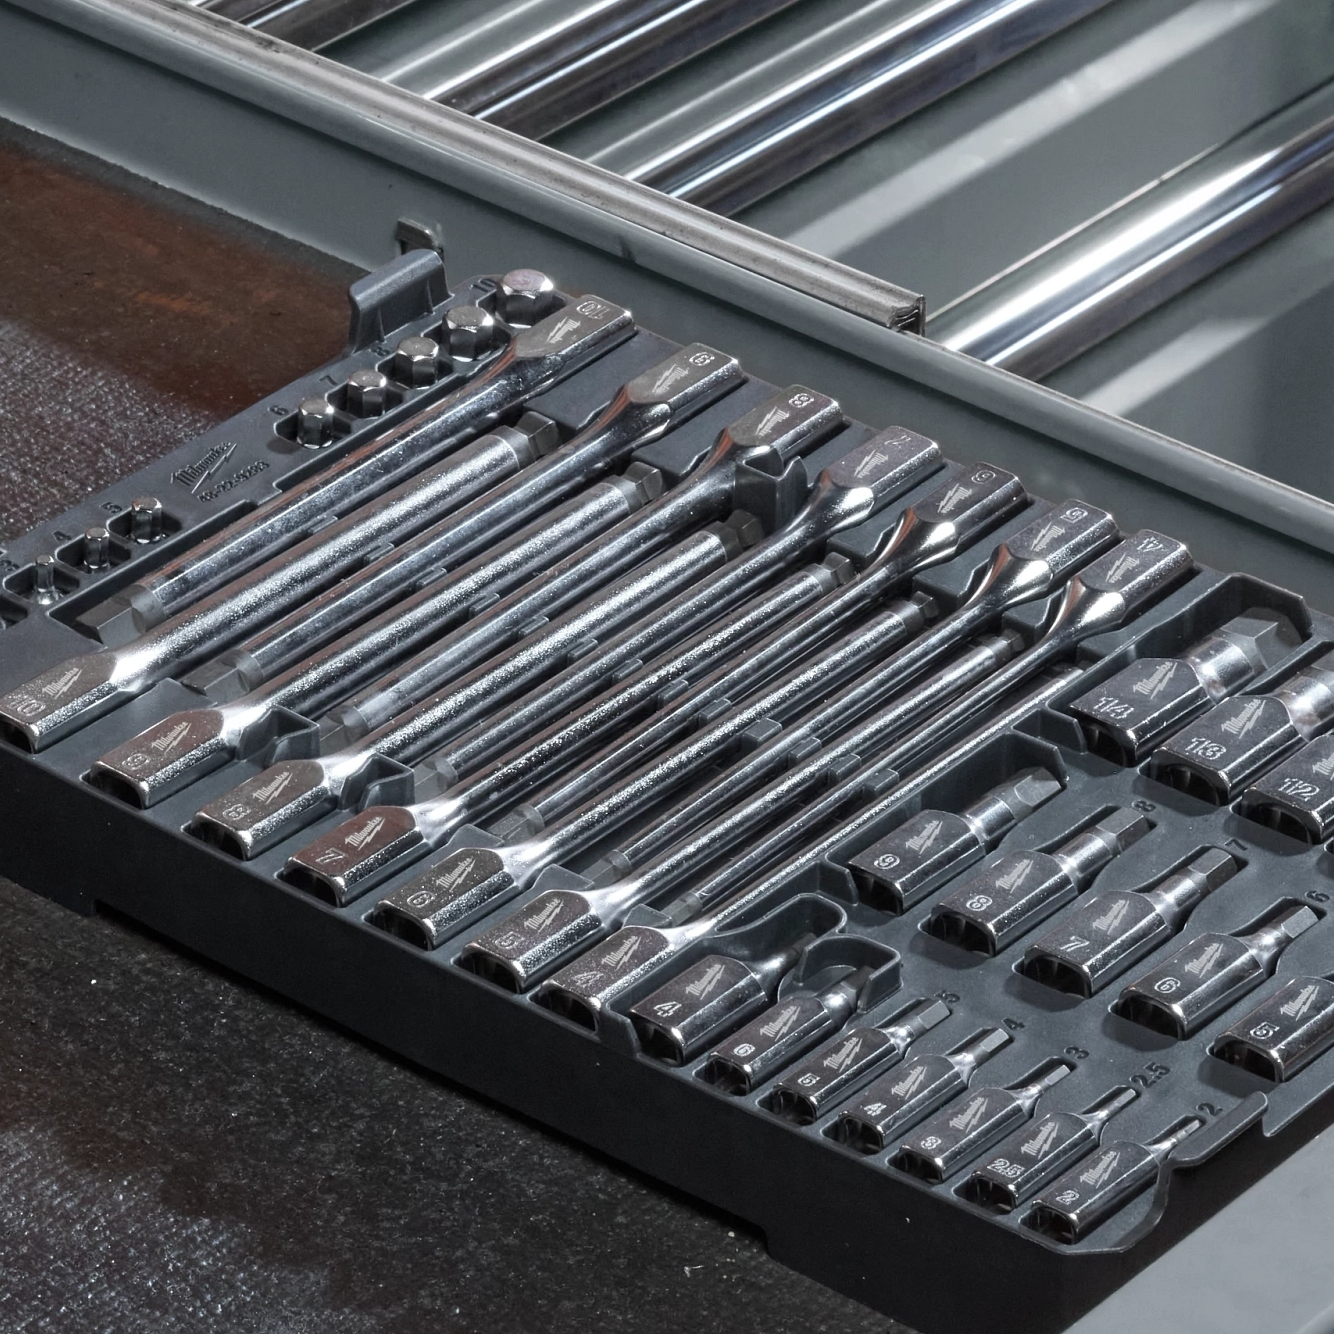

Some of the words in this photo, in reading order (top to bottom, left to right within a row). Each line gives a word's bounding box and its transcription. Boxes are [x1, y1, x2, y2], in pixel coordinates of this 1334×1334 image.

[318, 374, 339, 387] 7
[788, 392, 815, 409] 8
[170, 441, 232, 486] Milwaukee
[41, 666, 80, 697] Milwaukee
[1132, 661, 1173, 695] Milwaukee
[1092, 696, 1135, 719] 14
[1221, 698, 1262, 734] Milwaukee
[151, 720, 189, 751] Milwaukee
[1184, 737, 1227, 760] 13
[252, 771, 290, 802] Milwaukee
[1278, 777, 1320, 801] 12
[1131, 799, 1157, 813] 8
[344, 816, 382, 847] Milwaukee
[905, 819, 940, 851] Milwaukee
[1223, 838, 1249, 853] 7
[315, 847, 349, 864] 7
[873, 853, 901, 870] 9
[436, 857, 474, 889] Milwaukee
[995, 859, 1031, 891] Milwaukee
[966, 894, 993, 912] 8
[1305, 890, 1331, 904] 6
[524, 898, 562, 931] Milwaukee
[1092, 898, 1127, 931] Milwaukee
[601, 935, 639, 968] Milwaukee
[1059, 935, 1090, 952] 7
[1184, 942, 1220, 974] Milwaukee
[685, 963, 722, 997] Milwaukee
[1153, 976, 1181, 994] 6
[653, 1001, 682, 1018] 4
[1280, 984, 1315, 1017] Milwaukee
[760, 1004, 797, 1038] Milwaukee
[1249, 1021, 1280, 1039] 5
[823, 1036, 860, 1070] Milwaukee
[1063, 1046, 1090, 1060] 3
[797, 1072, 821, 1087] 5
[891, 1065, 924, 1097] Milwaukee
[1129, 1062, 1171, 1089] 2.5
[863, 1102, 887, 1116] 4
[949, 1096, 986, 1131] Milwaukee
[1195, 1101, 1223, 1118] 2
[1021, 1121, 1056, 1156] Milwaukee
[1079, 1150, 1117, 1186] Milwaukee
[1055, 1189, 1080, 1205] 2
